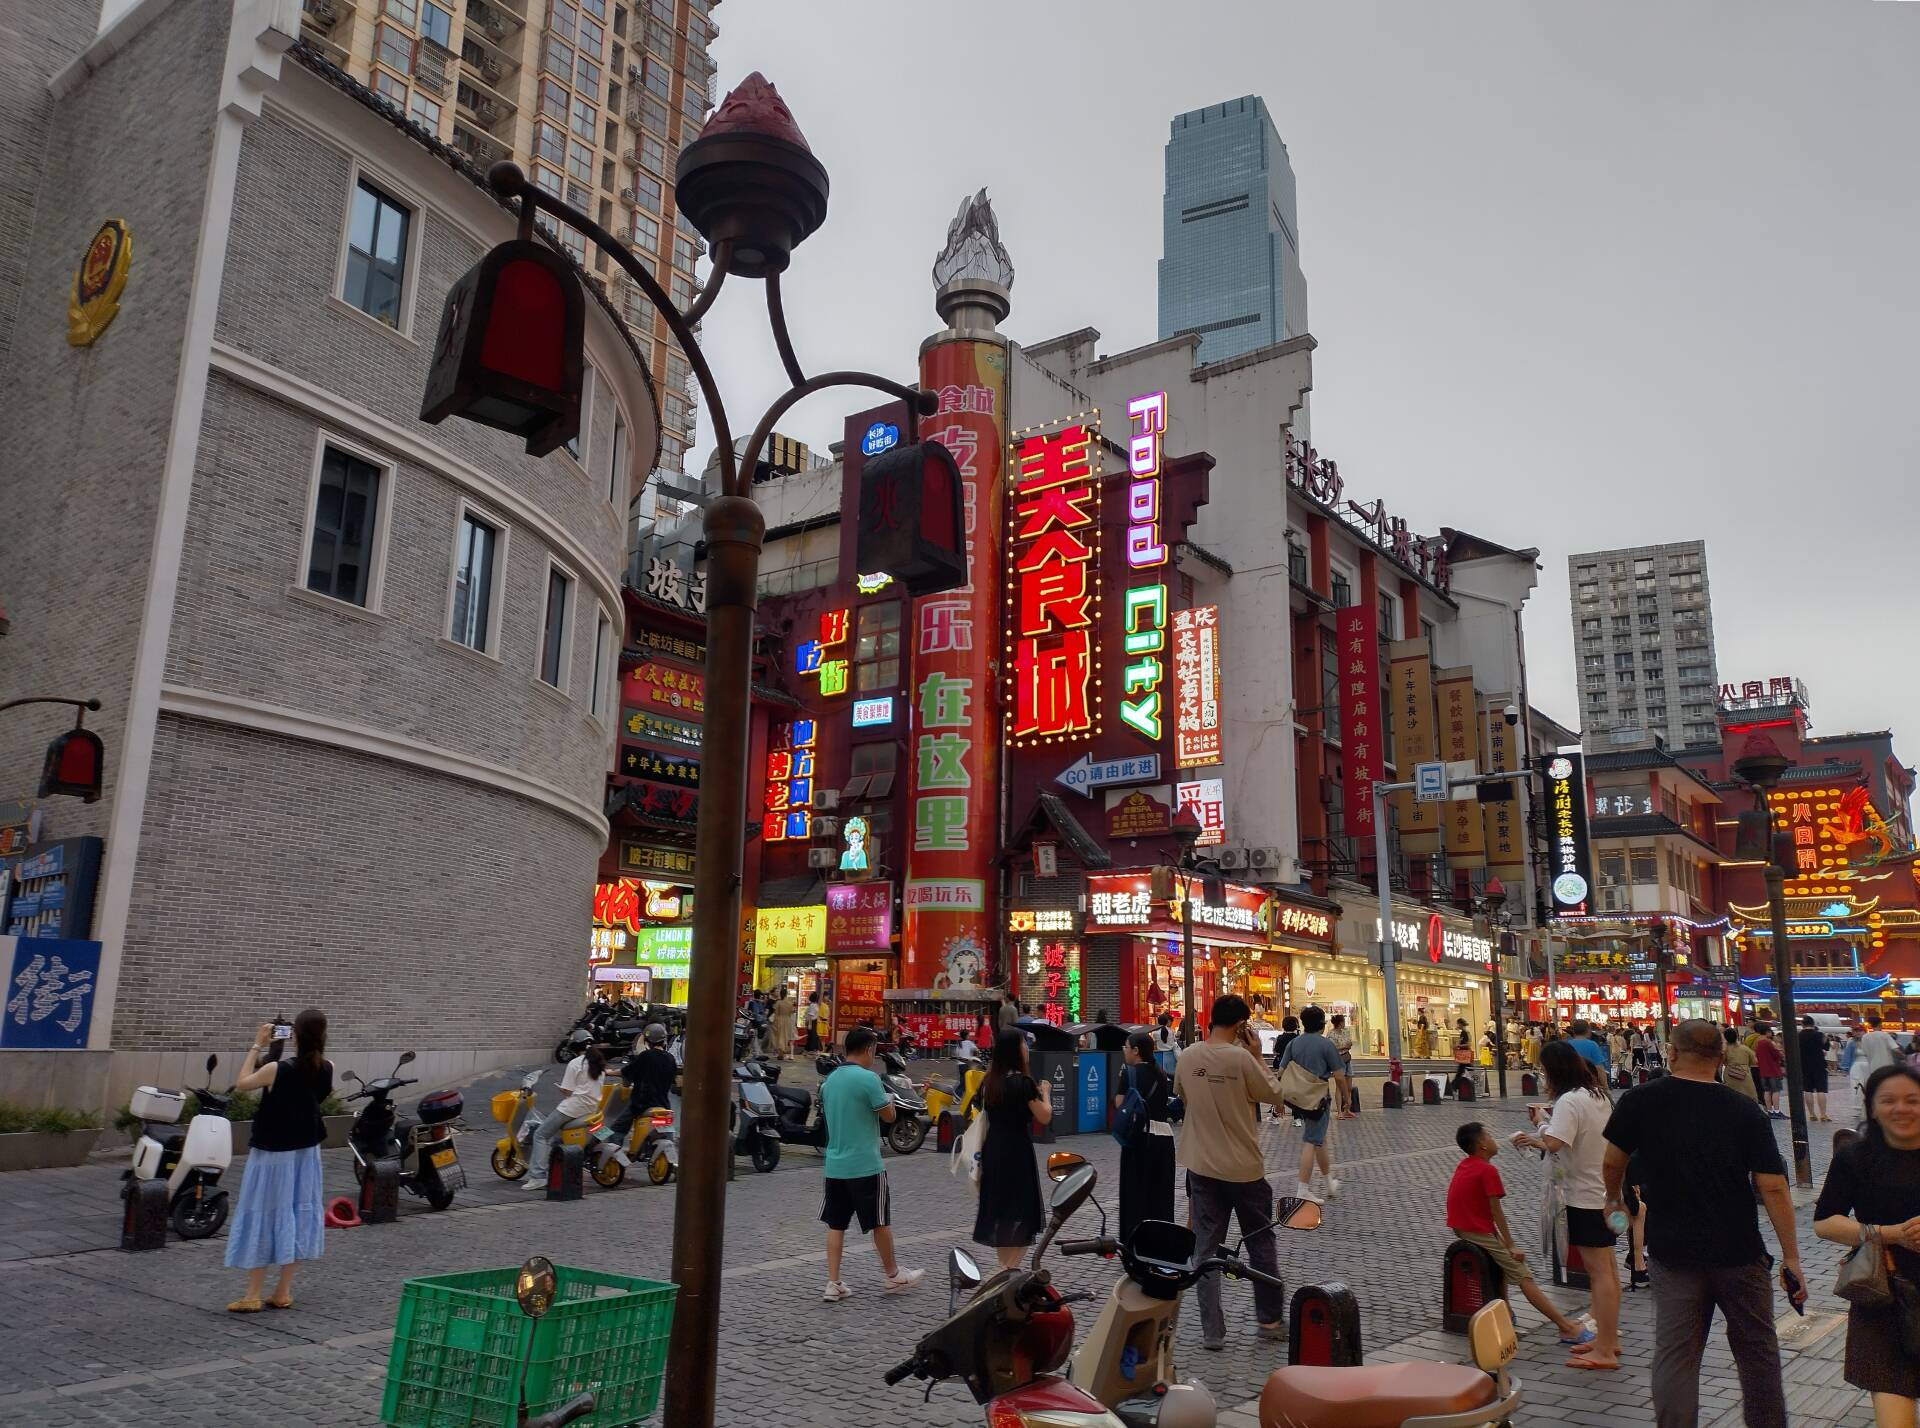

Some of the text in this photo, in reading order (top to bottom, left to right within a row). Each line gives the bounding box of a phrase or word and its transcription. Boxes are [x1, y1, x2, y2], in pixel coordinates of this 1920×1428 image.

[922, 385, 995, 419] 食城
[1013, 425, 1093, 737] 美食城
[1120, 391, 1168, 741] Food City
[1348, 618, 1373, 824] 北有城隍庙南有坡子街
[1404, 668, 1418, 729] 千年老長沙
[1091, 892, 1152, 915] 甜老虎
[1044, 943, 1065, 1027] 坡子街
